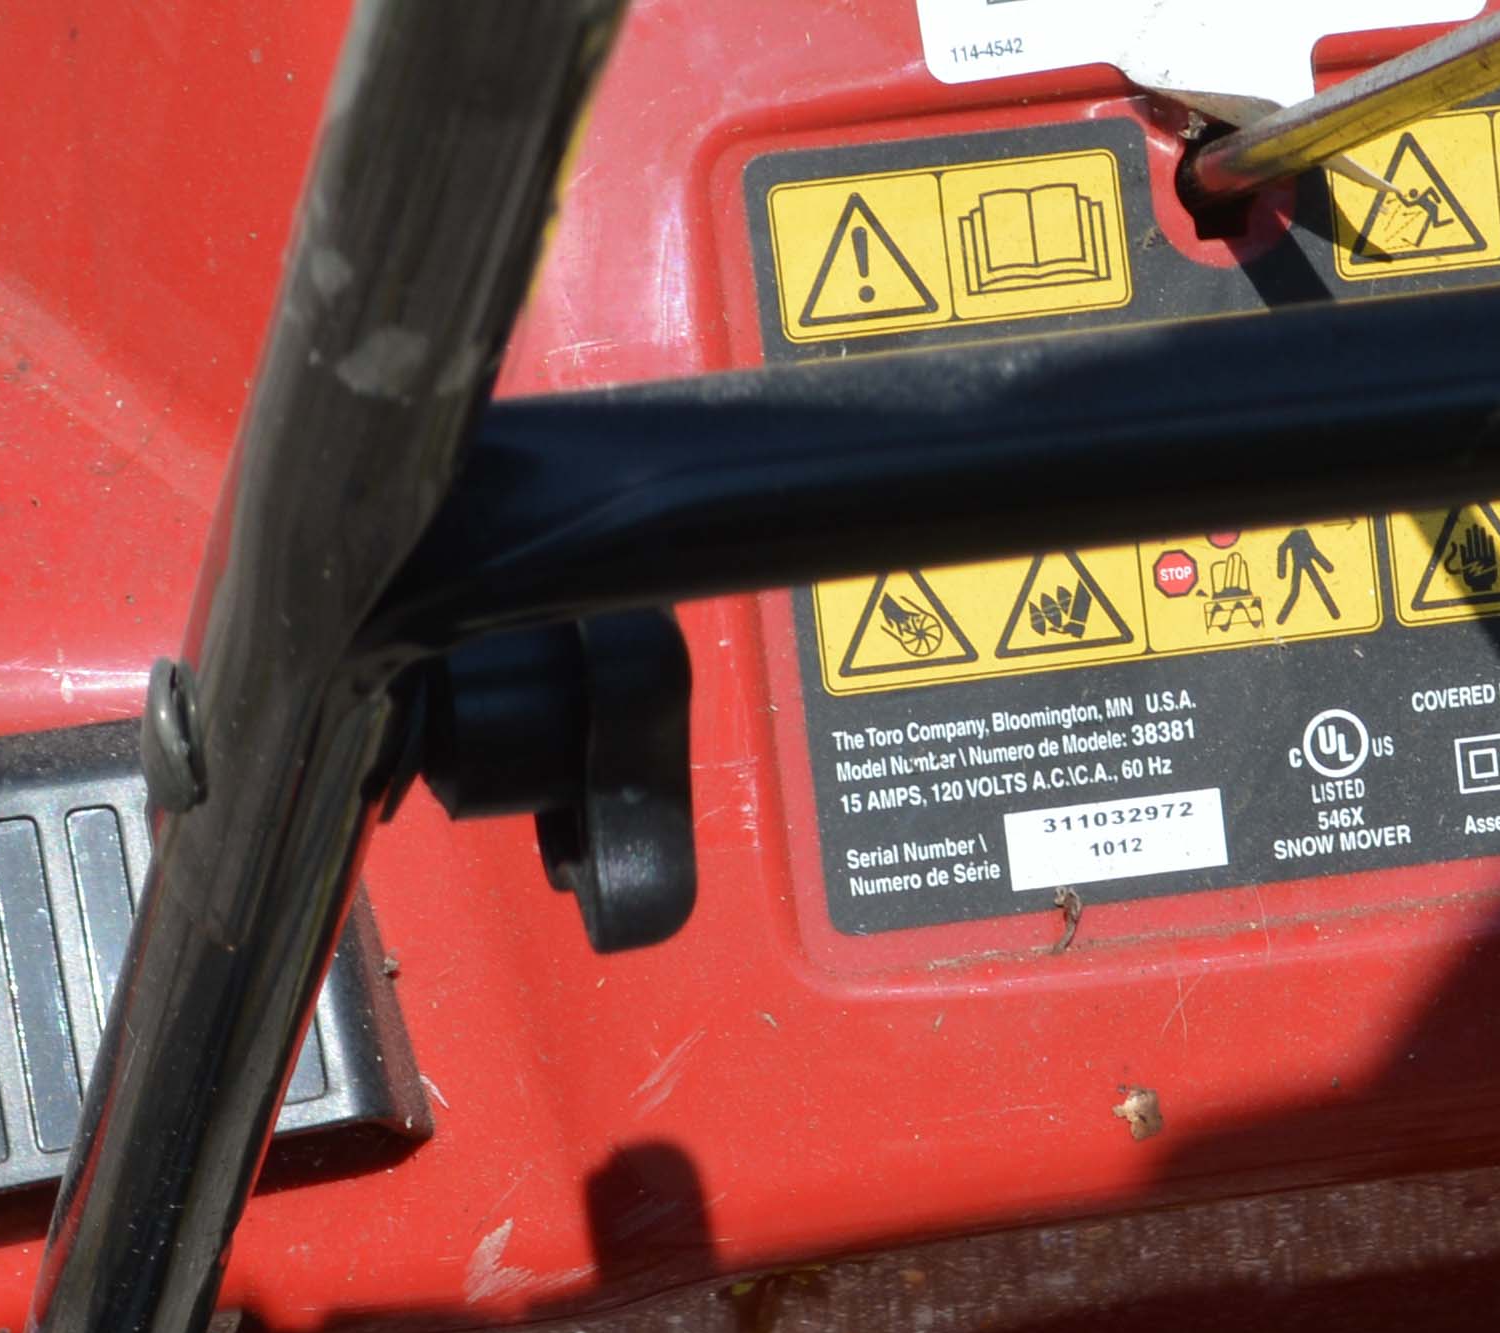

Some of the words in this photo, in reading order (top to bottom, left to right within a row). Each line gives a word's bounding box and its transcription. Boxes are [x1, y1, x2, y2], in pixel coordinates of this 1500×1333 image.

[950, 37, 1023, 62] 114-4542
[1160, 566, 1191, 581] STOP
[1411, 684, 1495, 713] COVERED
[832, 731, 865, 751] The
[865, 728, 903, 747] Toro
[907, 718, 990, 743] Company,
[992, 703, 1103, 732] Bloomington,
[1105, 697, 1134, 718] MN
[1145, 689, 1196, 713] U.S.A.
[836, 757, 887, 782] Model
[891, 751, 956, 775] Number
[969, 743, 1035, 766] Numero
[1039, 738, 1059, 758] de
[1063, 730, 1128, 754] Modele:
[1131, 718, 1195, 746] 38381
[1317, 725, 1354, 762] UL
[1372, 735, 1394, 757] US
[840, 793, 862, 813] 15
[867, 785, 928, 811] AMPS,
[931, 781, 963, 803] 120
[965, 773, 1028, 797] VOLTS
[1121, 759, 1143, 780] 60
[1148, 756, 1172, 776] Hz
[1311, 778, 1365, 804] LISTED
[1043, 801, 1194, 833] 311032972
[1317, 806, 1364, 830] 546X
[846, 844, 899, 869] Serial
[903, 838, 975, 862] Number
[1090, 837, 1143, 857] 1012
[1273, 834, 1334, 860] SNOW
[1340, 825, 1411, 851] MOVER
[850, 873, 922, 897] Numero
[926, 867, 949, 887] de
[953, 860, 1001, 884] Série
